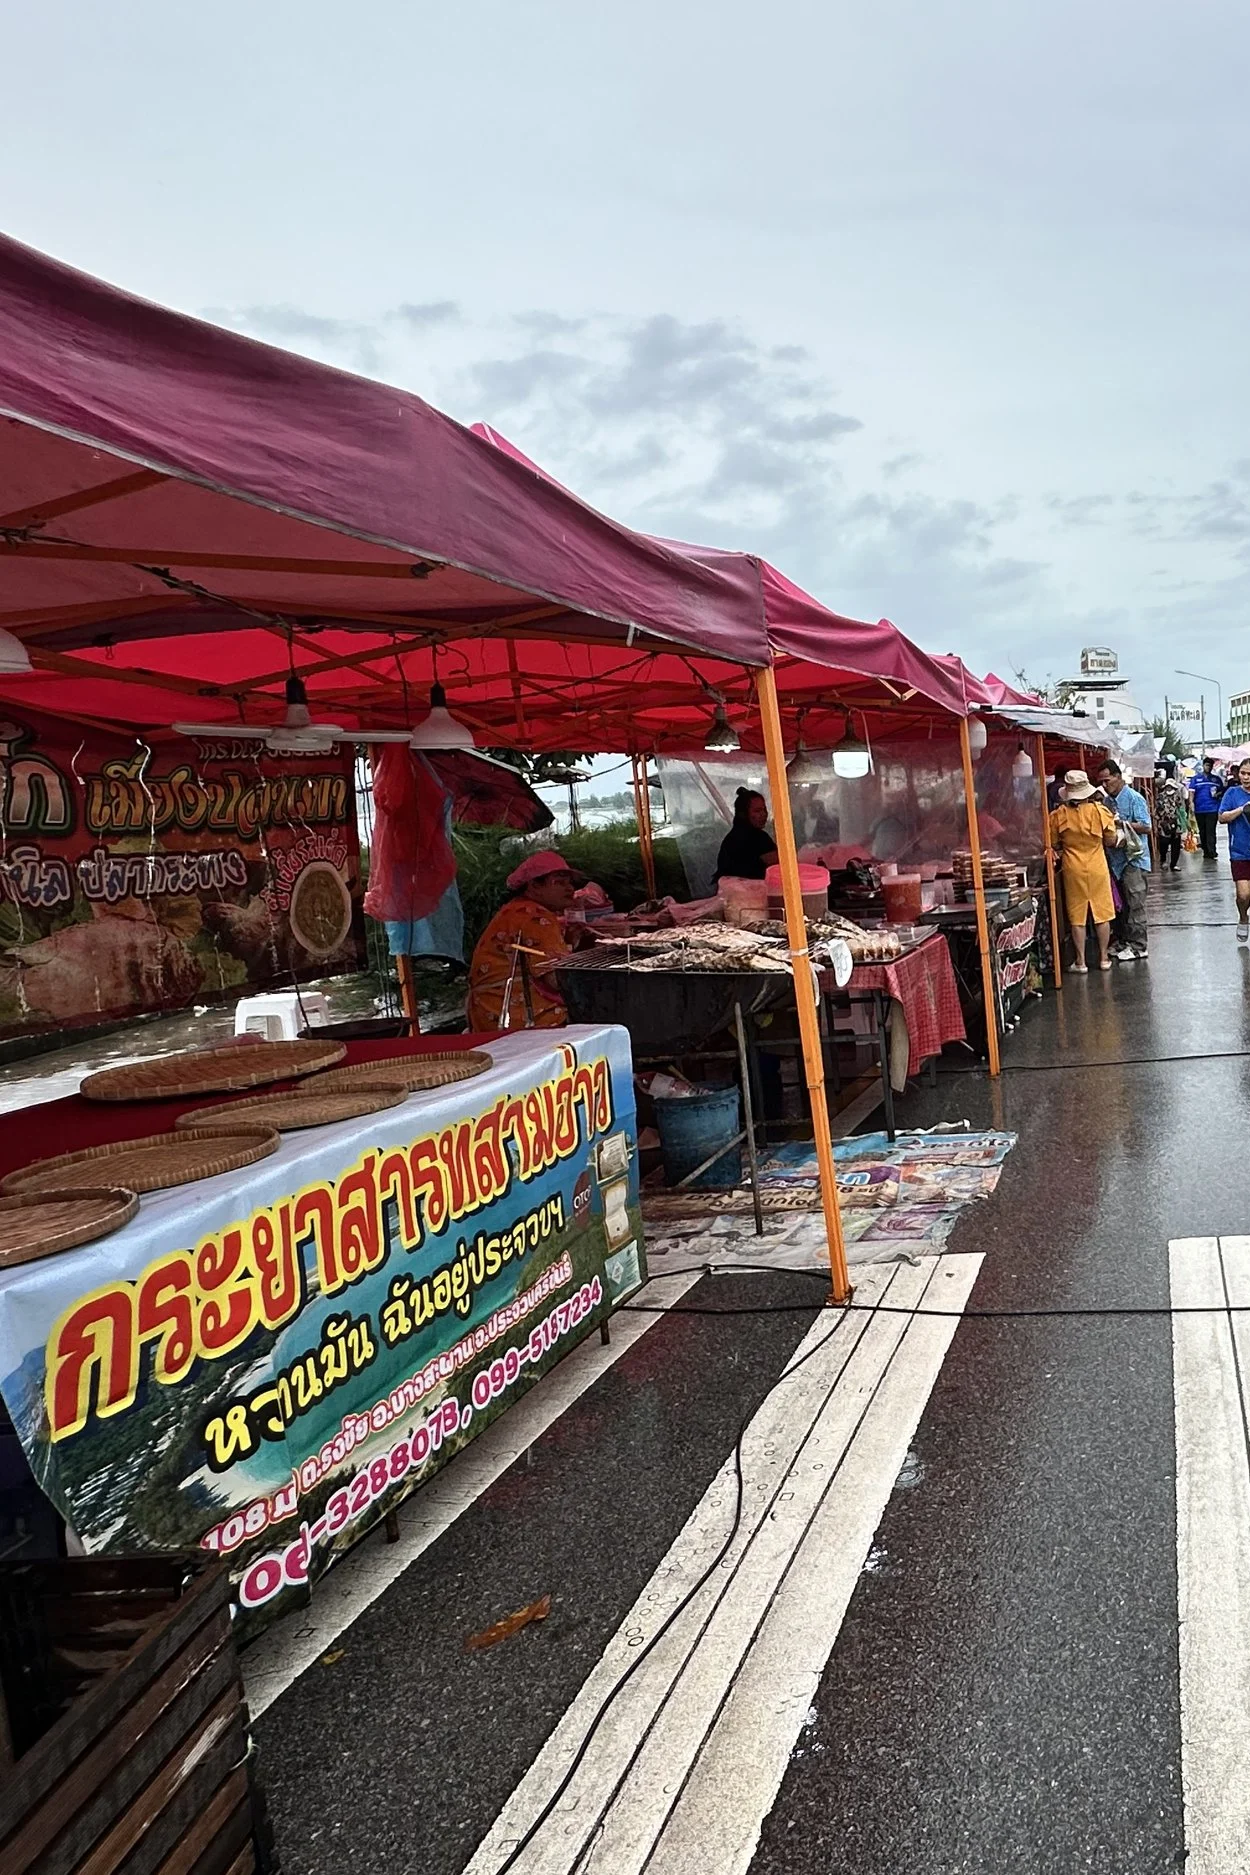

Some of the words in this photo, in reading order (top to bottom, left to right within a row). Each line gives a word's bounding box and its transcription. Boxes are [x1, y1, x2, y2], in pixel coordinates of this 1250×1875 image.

[49, 1043, 614, 1442] กระยาสารทสามอ่าว
[205, 1315, 374, 1464] หวานมัน
[384, 1194, 567, 1340] ฉันอยู่ประจวบฯ
[472, 1277, 602, 1409] 099-5187234
